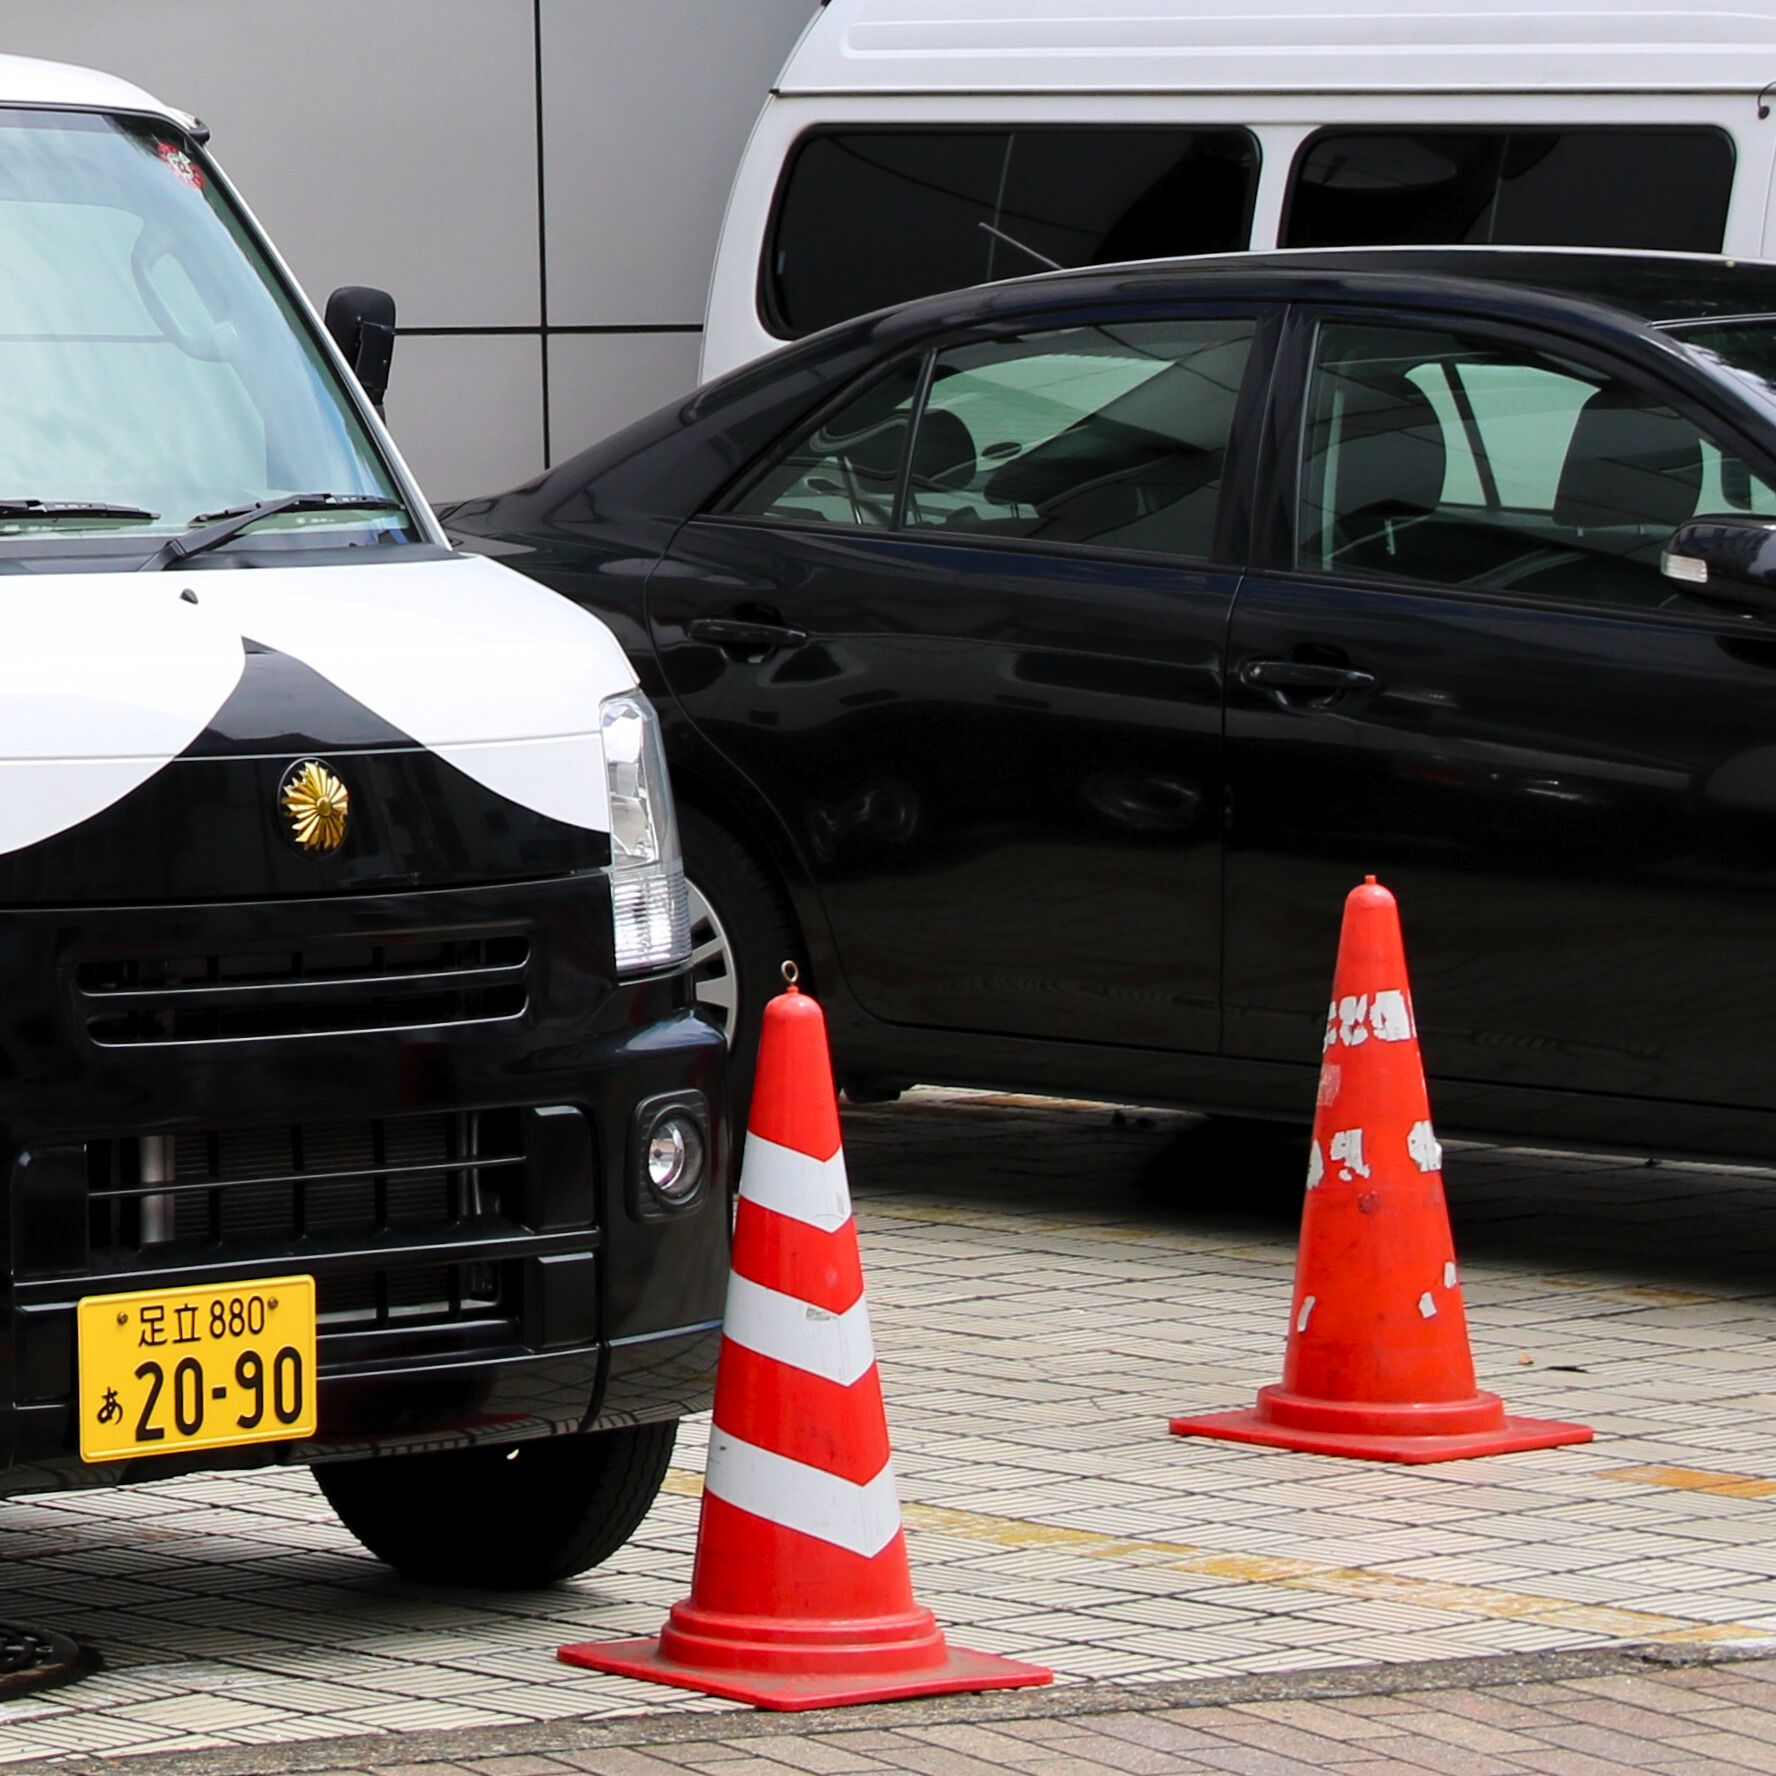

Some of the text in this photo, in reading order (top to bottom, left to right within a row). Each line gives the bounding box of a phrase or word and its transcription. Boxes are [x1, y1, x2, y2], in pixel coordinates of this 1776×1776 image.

[138, 1295, 265, 1348] 足立 880
[96, 1345, 303, 1443] あ 20-90
